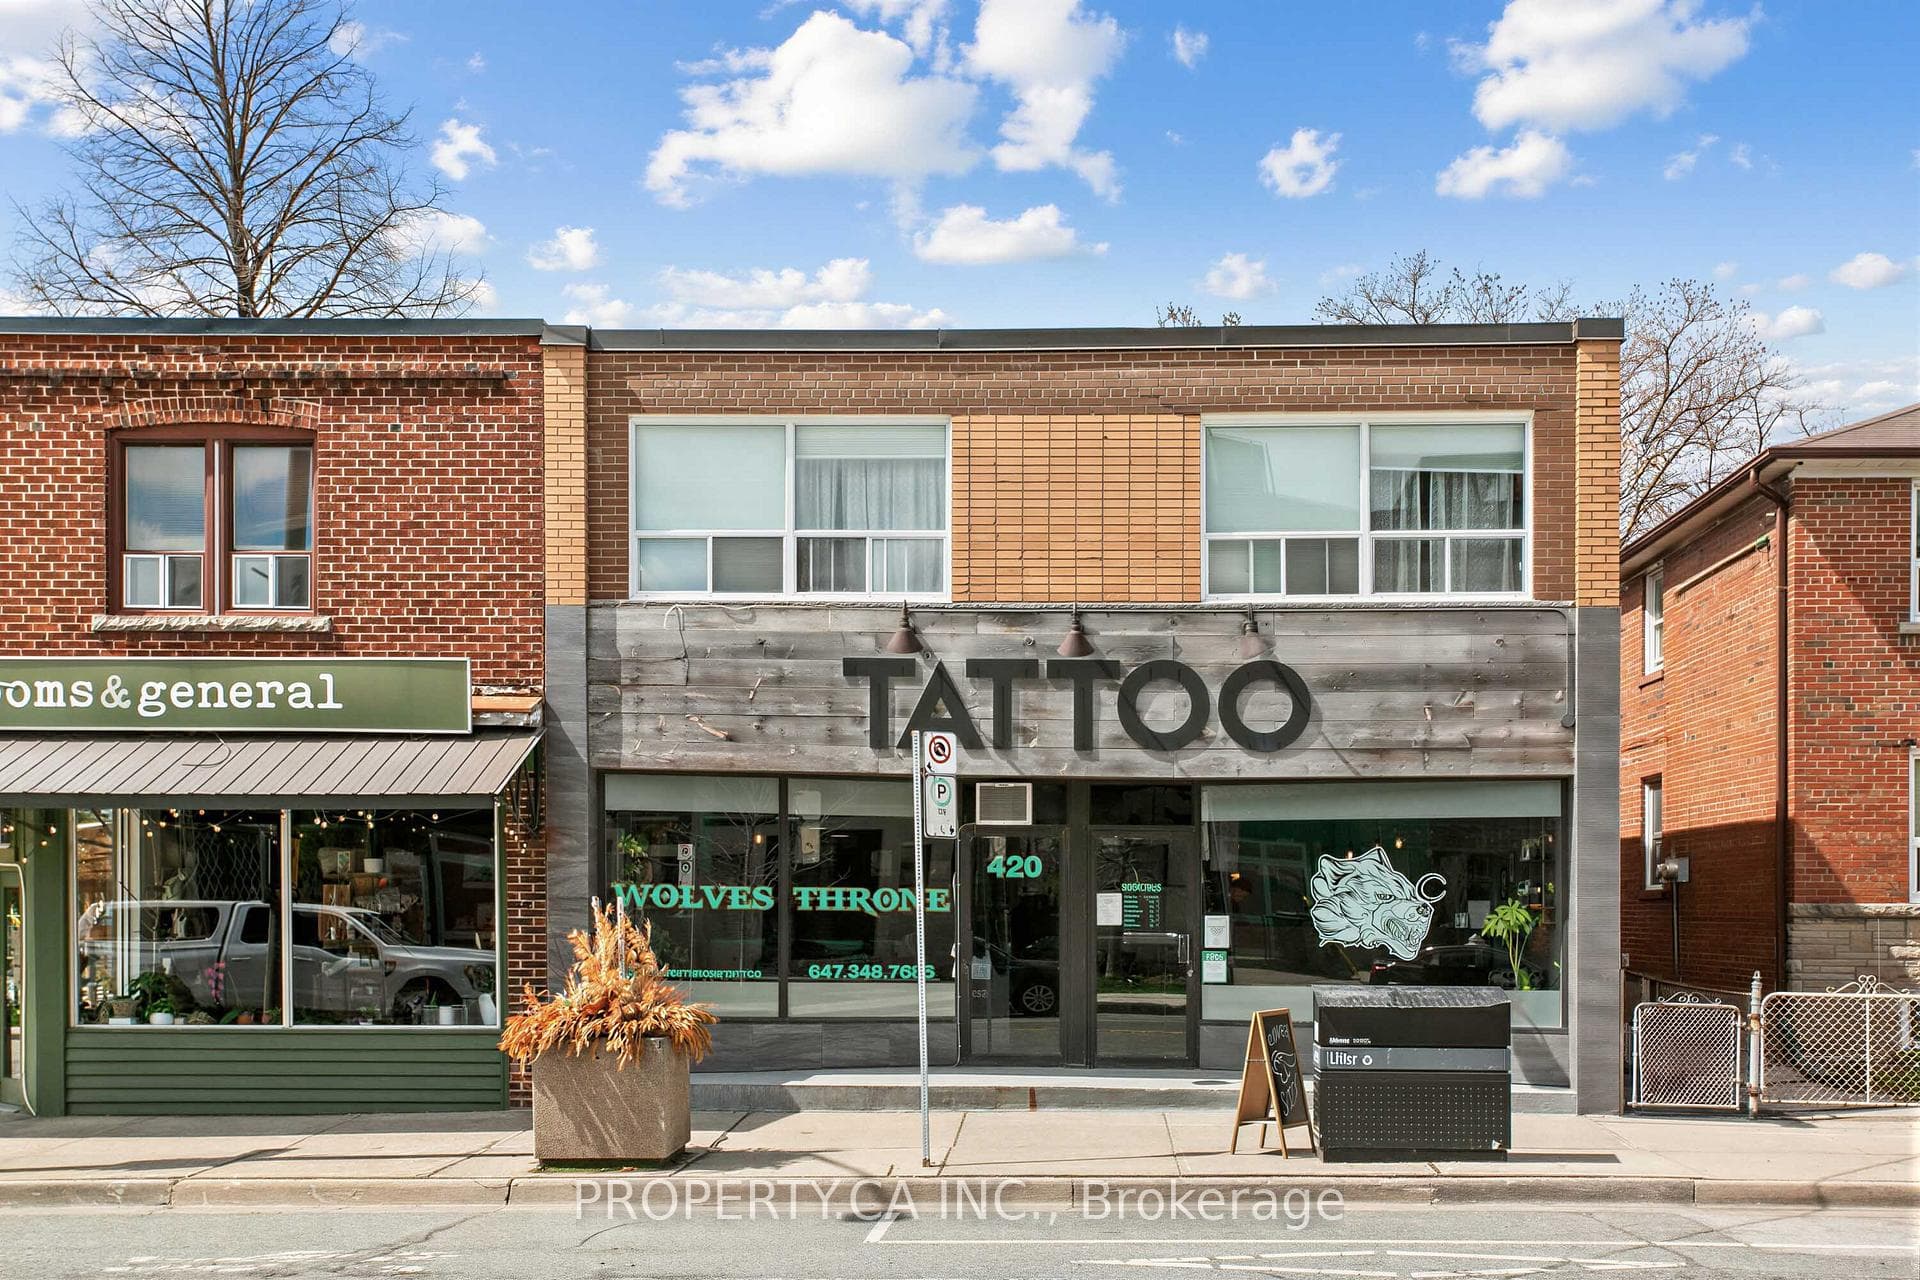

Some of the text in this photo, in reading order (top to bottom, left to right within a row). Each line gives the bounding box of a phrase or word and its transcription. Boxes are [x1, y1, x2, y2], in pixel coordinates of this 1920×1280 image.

[0, 680, 93, 708] oms
[137, 673, 343, 717] general
[843, 658, 1311, 752] TATTOO
[937, 784, 947, 799] P
[987, 855, 1042, 879] 420
[611, 884, 950, 917] WOLVES THRONE
